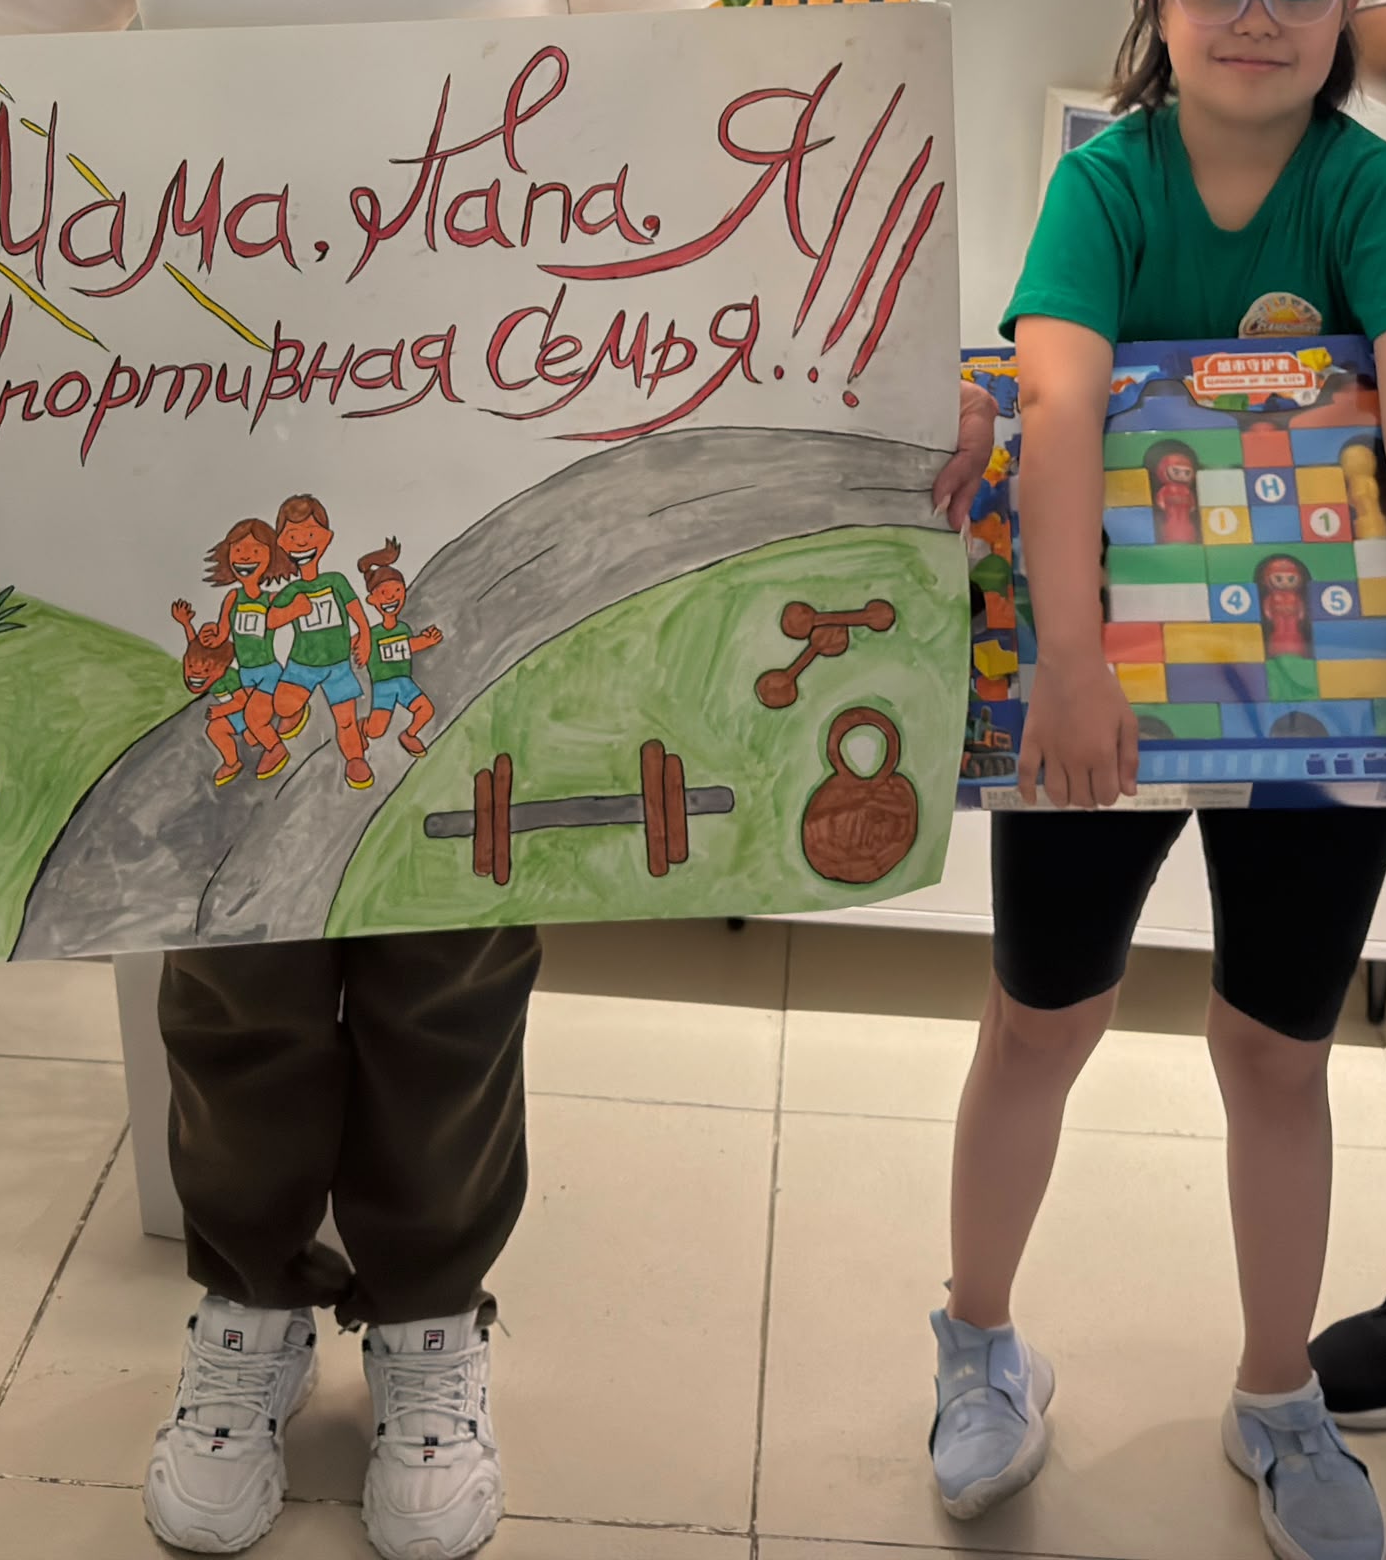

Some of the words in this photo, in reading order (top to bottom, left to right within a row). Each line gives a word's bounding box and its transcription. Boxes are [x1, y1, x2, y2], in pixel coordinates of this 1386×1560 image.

[1261, 478, 1280, 498] H
[1319, 512, 1330, 532] 1
[1227, 590, 1243, 610] 4
[1329, 590, 1346, 611] 5
[238, 613, 259, 632] 10
[382, 644, 408, 661] 04
